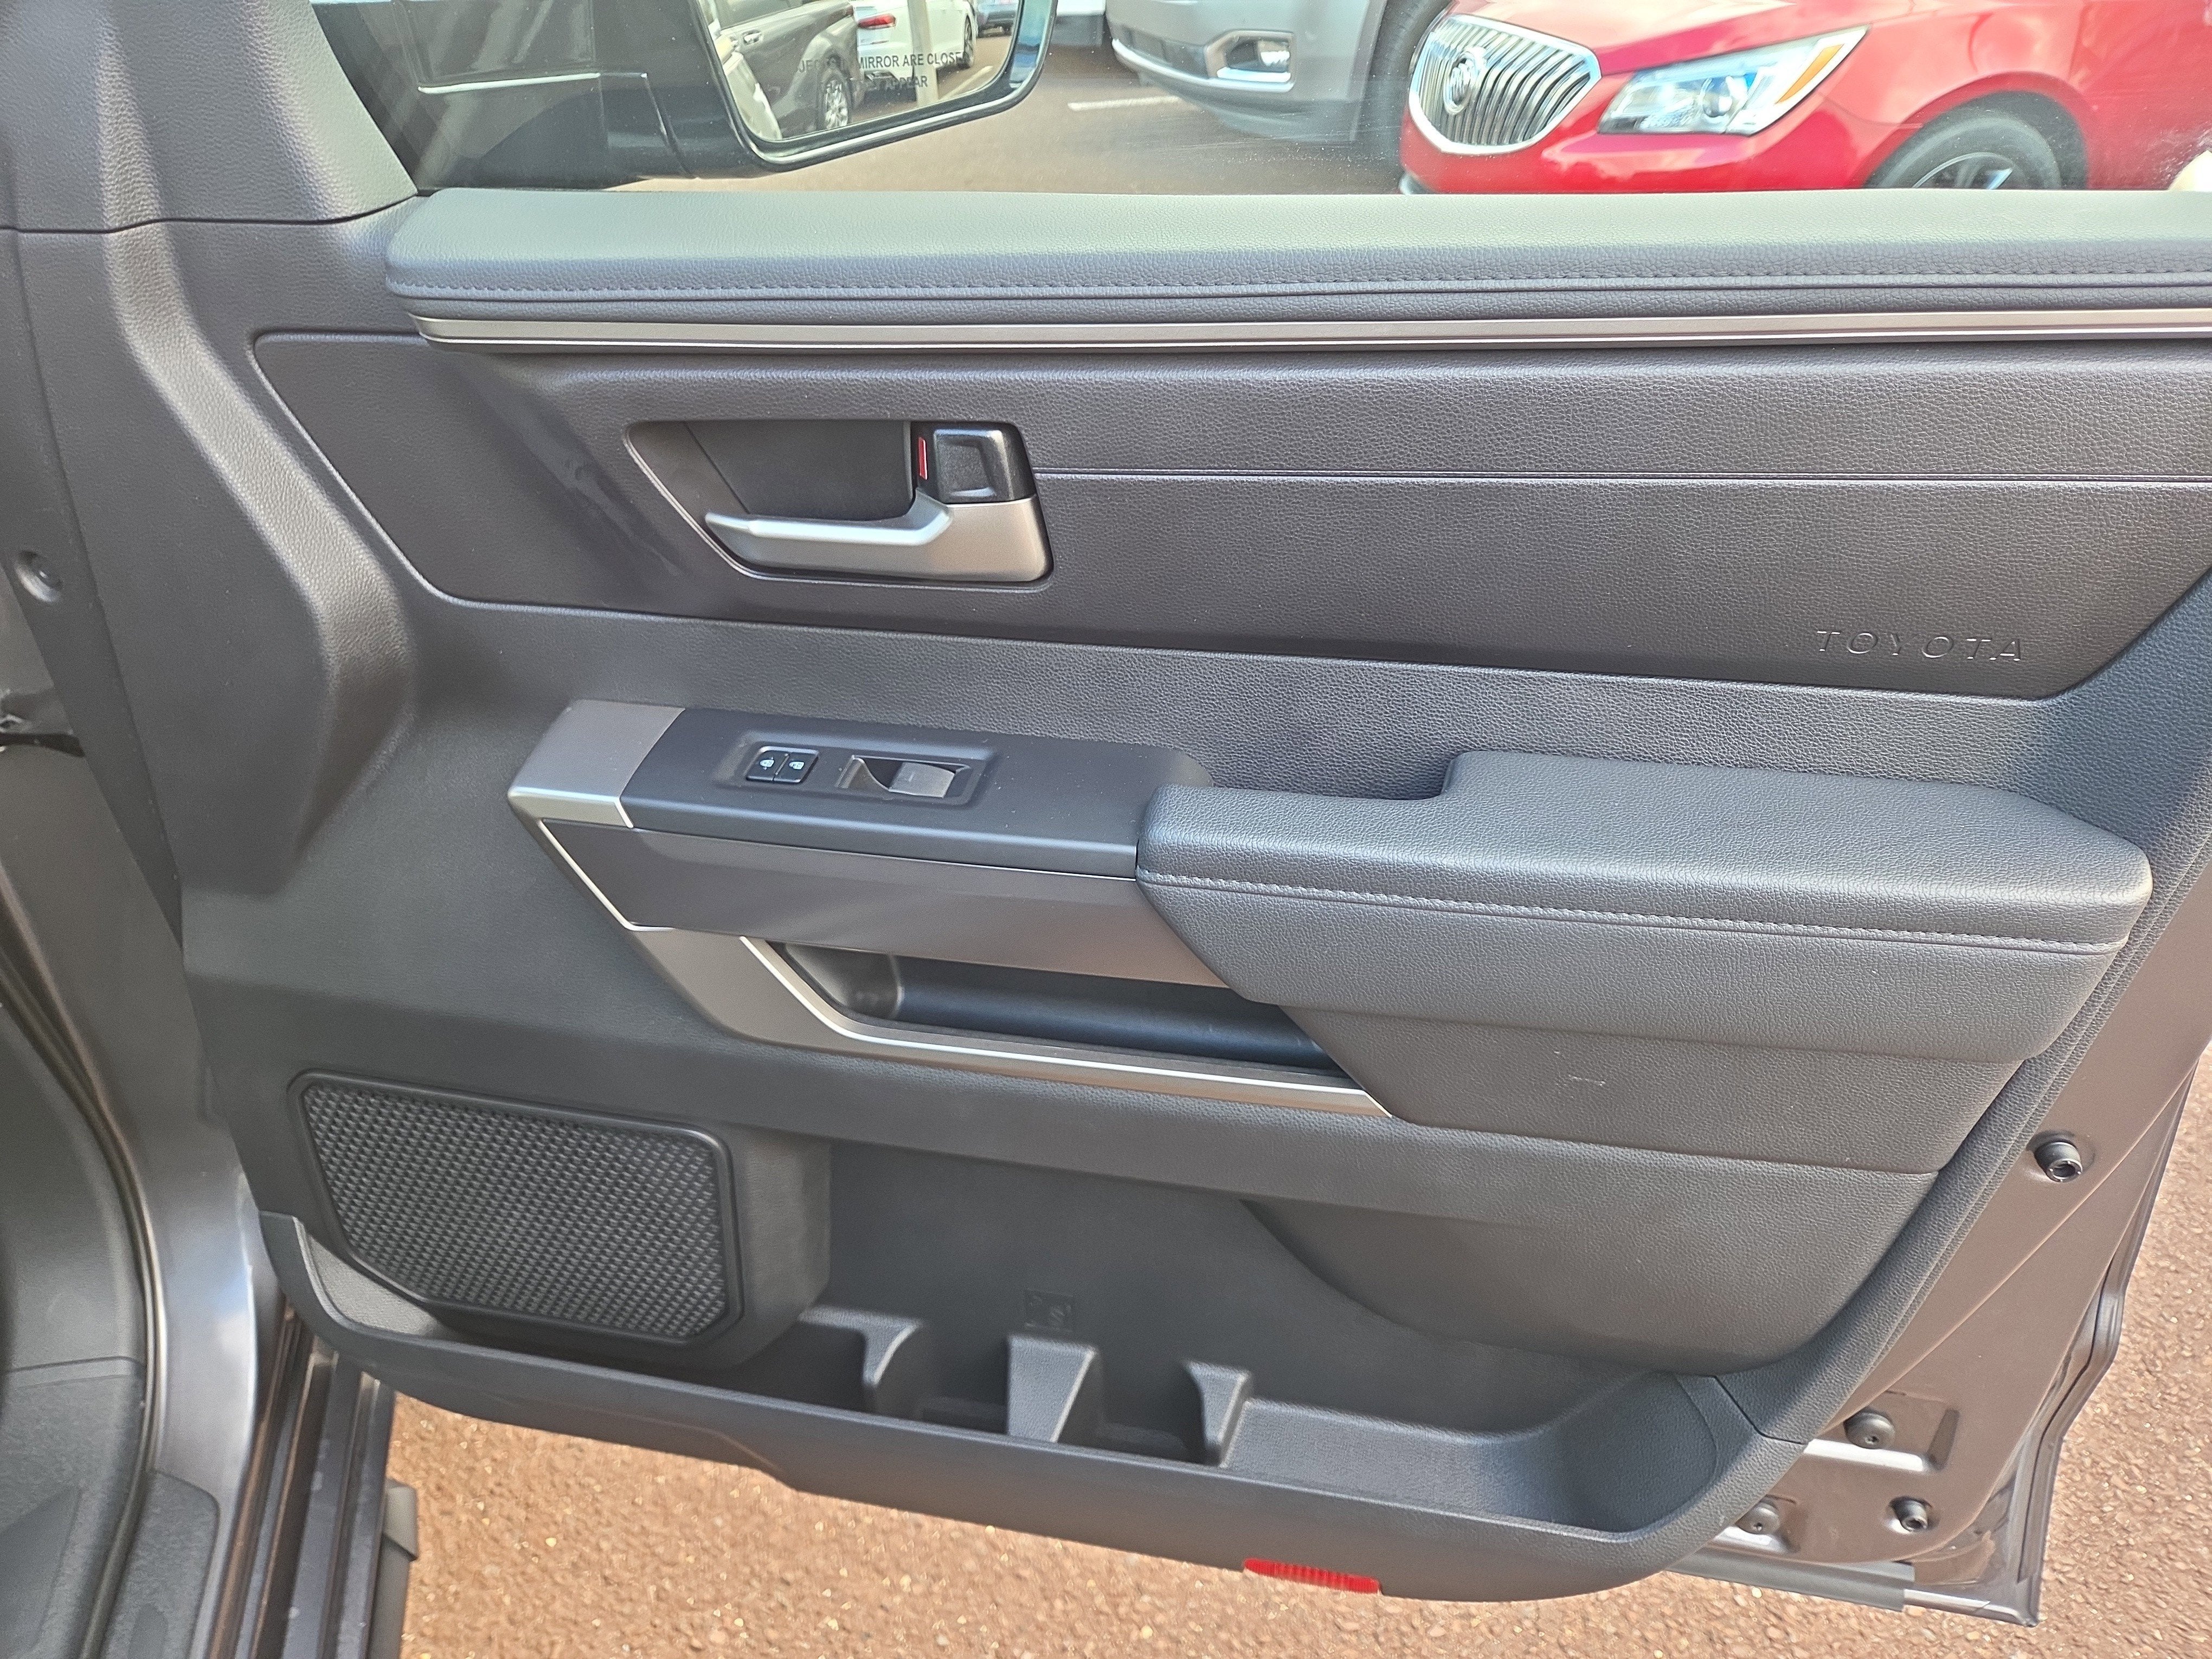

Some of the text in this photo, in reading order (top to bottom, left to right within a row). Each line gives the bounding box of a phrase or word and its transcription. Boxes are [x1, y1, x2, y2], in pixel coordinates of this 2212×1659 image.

[902, 54, 924, 67] ARE
[927, 52, 968, 65] CLOSE
[1816, 630, 2022, 661] TOYOTA
